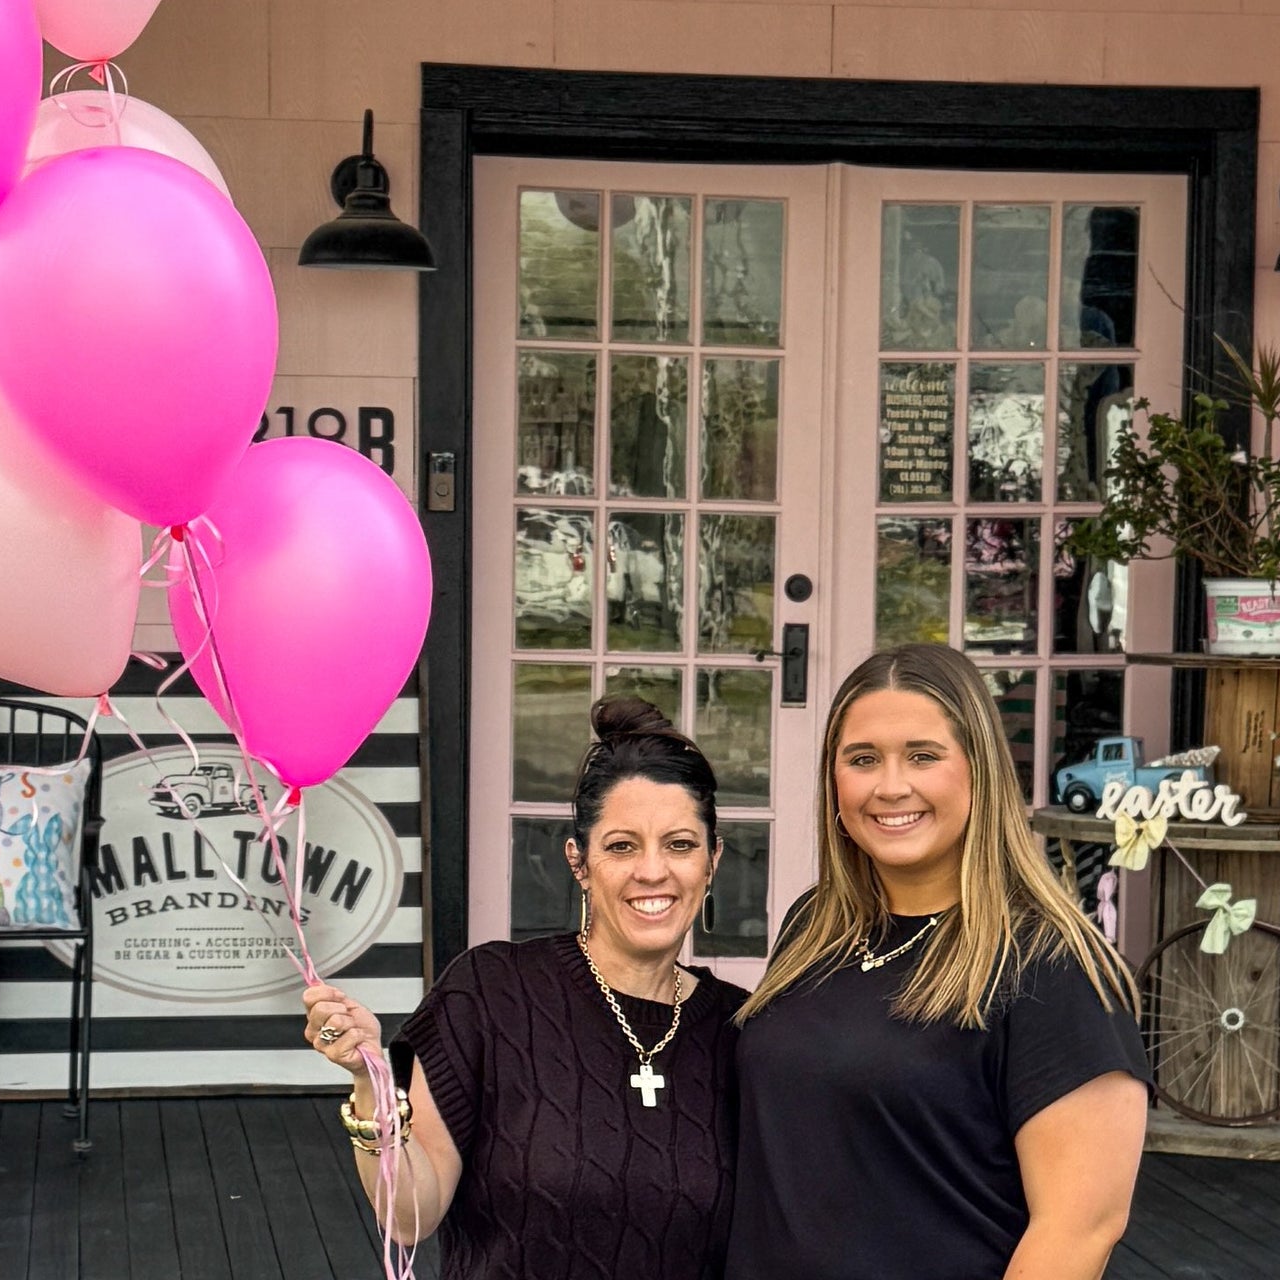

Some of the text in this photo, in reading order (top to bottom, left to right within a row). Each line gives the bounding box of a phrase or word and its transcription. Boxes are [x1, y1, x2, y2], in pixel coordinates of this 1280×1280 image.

[1096, 770, 1246, 826] easter
[88, 830, 373, 913] MALL TOWN
[105, 892, 312, 926] BRANDING
[124, 938, 191, 948] CLOTHING
[136, 950, 171, 960] GEAR
[188, 949, 241, 960] CUSTOM
